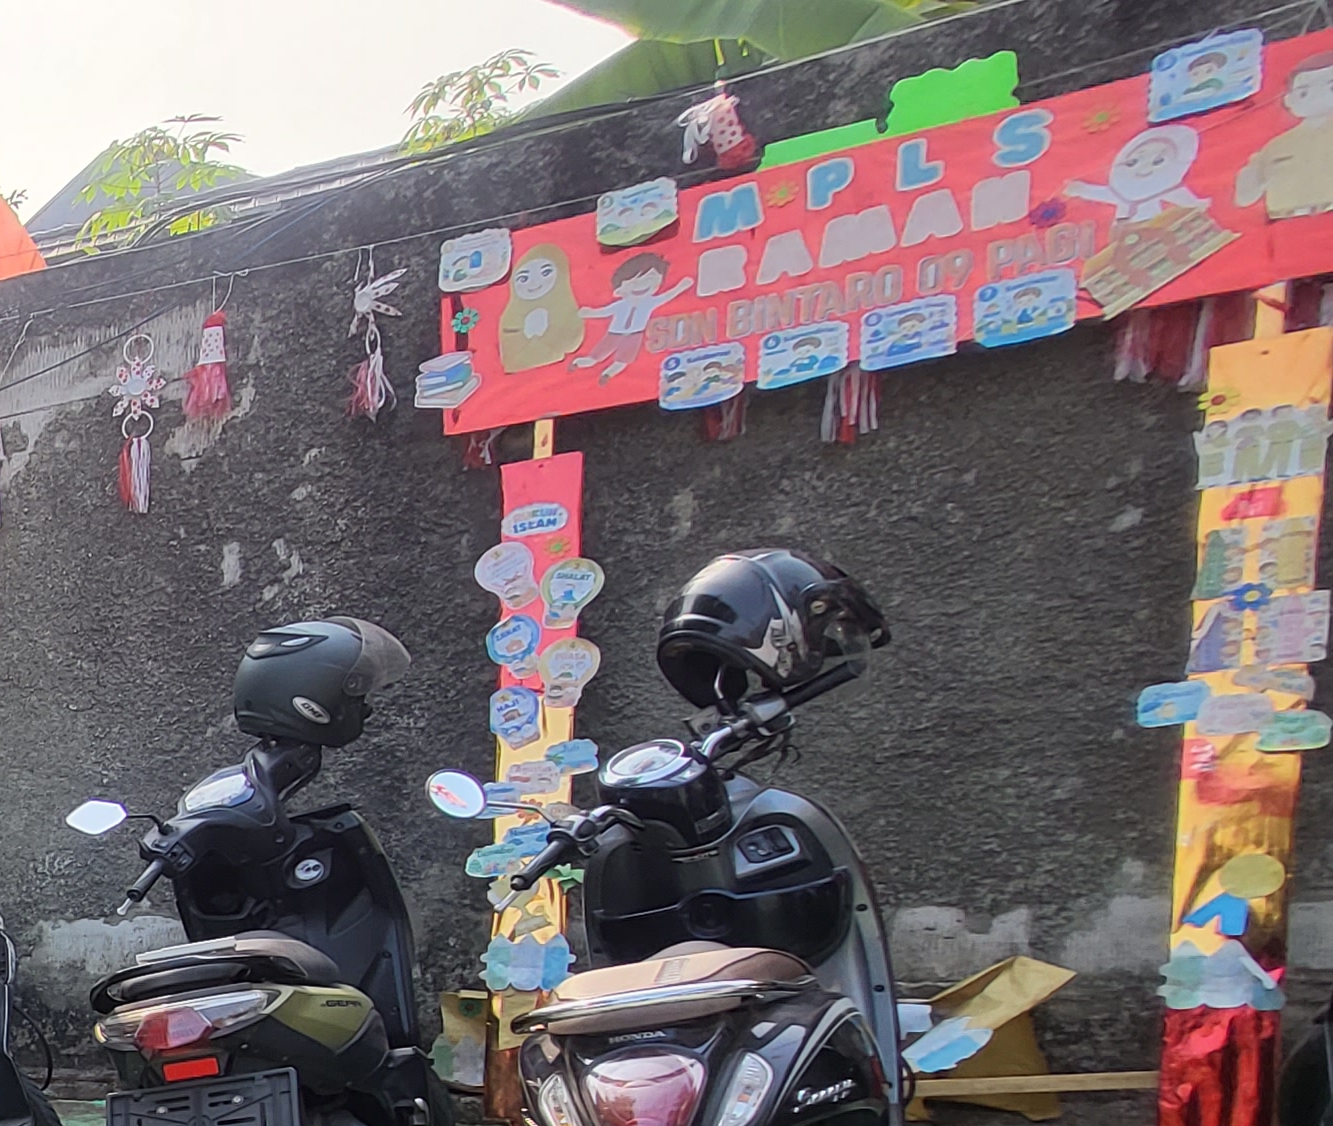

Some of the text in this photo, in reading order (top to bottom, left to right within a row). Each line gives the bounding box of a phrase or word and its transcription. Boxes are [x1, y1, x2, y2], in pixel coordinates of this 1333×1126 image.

[646, 220, 1097, 354] SDN BINTARO 09 PAGI
[513, 517, 558, 534] ISLAM
[555, 571, 592, 582] SHALAT
[496, 698, 520, 713] HAJI
[608, 1030, 667, 1045] HONDA
